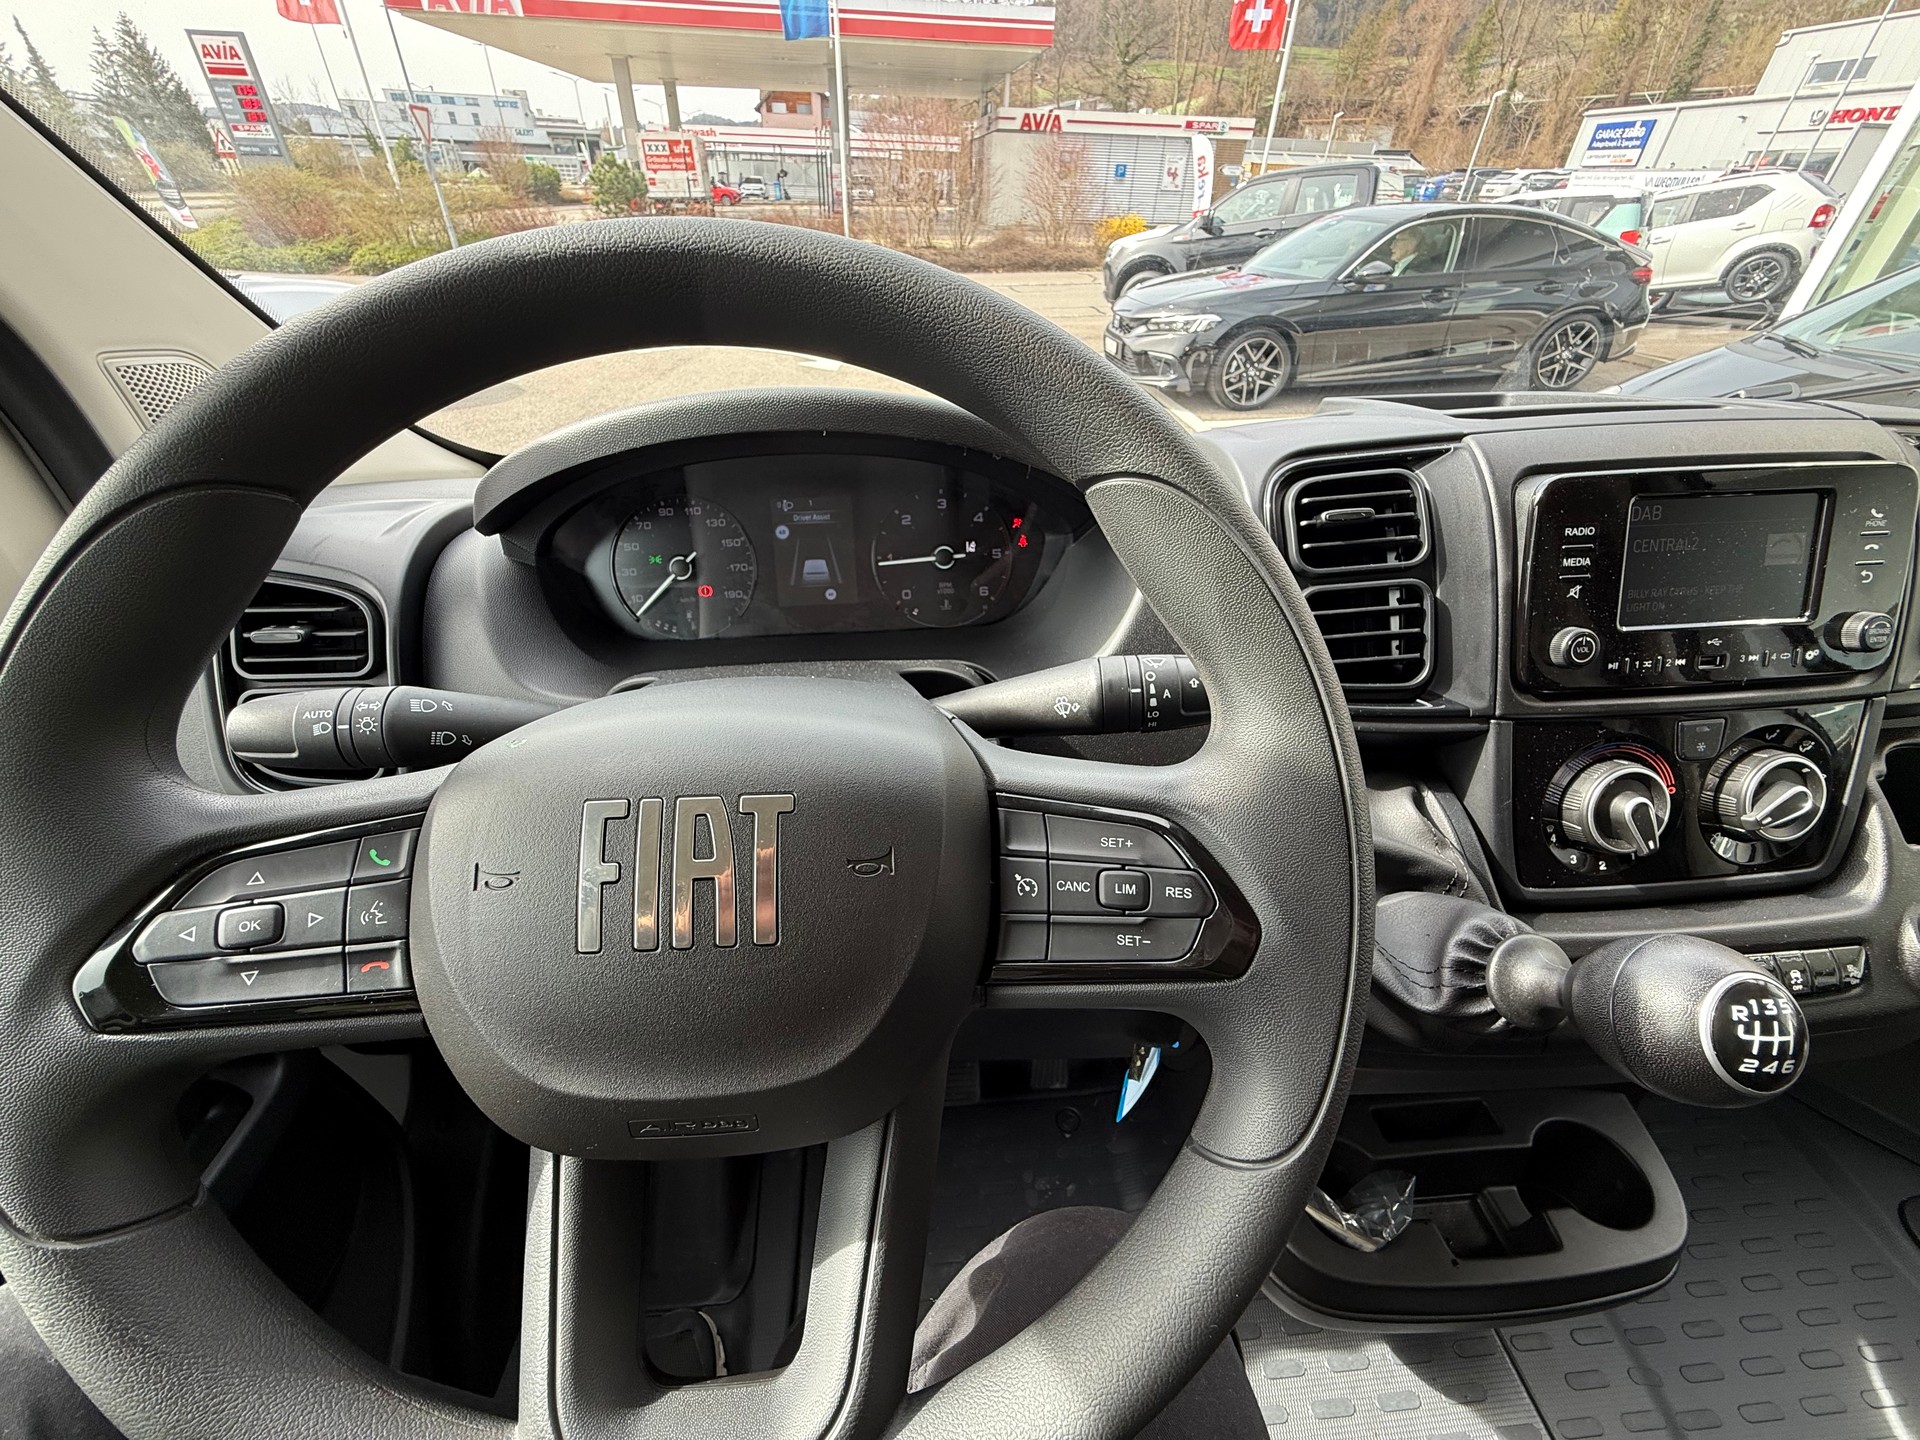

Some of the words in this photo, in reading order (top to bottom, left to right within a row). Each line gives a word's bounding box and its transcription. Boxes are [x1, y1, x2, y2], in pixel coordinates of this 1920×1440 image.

[1828, 105, 1902, 123] HOND
[1191, 121, 1219, 130] SPAR
[937, 499, 947, 509] 3
[658, 508, 674, 516] 90
[685, 507, 701, 515] 110
[1631, 505, 1662, 521] DAB
[901, 515, 911, 525] 2
[973, 512, 983, 522] 4
[636, 522, 651, 530] 70
[705, 519, 726, 527] 130
[1565, 526, 1596, 536] RADIO
[624, 543, 639, 551] 50
[721, 539, 741, 547] 150
[992, 549, 1001, 559] 5
[1563, 557, 1591, 567] MEDIA
[622, 568, 637, 577] 30
[902, 590, 912, 599] 0
[979, 586, 989, 596] 6
[631, 594, 643, 603] 10
[1666, 659, 1672, 667] 2
[1739, 655, 1745, 663] 3
[1635, 661, 1640, 669] 1
[1163, 689, 1171, 699] A
[302, 709, 333, 719] AUTO
[1100, 838, 1134, 848] SET+
[1550, 833, 1556, 843] 4
[1570, 855, 1577, 864] 3
[1598, 861, 1607, 870] 2
[577, 793, 796, 954] FIAT
[1056, 881, 1091, 893] CANC
[1115, 884, 1137, 895] LIM
[1165, 887, 1193, 899] RES
[238, 919, 261, 932] OK
[1731, 1005, 1749, 1022] R
[1749, 999, 1760, 1015] 1
[1764, 999, 1778, 1015] 3
[1780, 999, 1793, 1015] 5
[1738, 1058, 1760, 1073] 2
[1762, 1060, 1778, 1074] 4
[1781, 1060, 1795, 1074] 6
